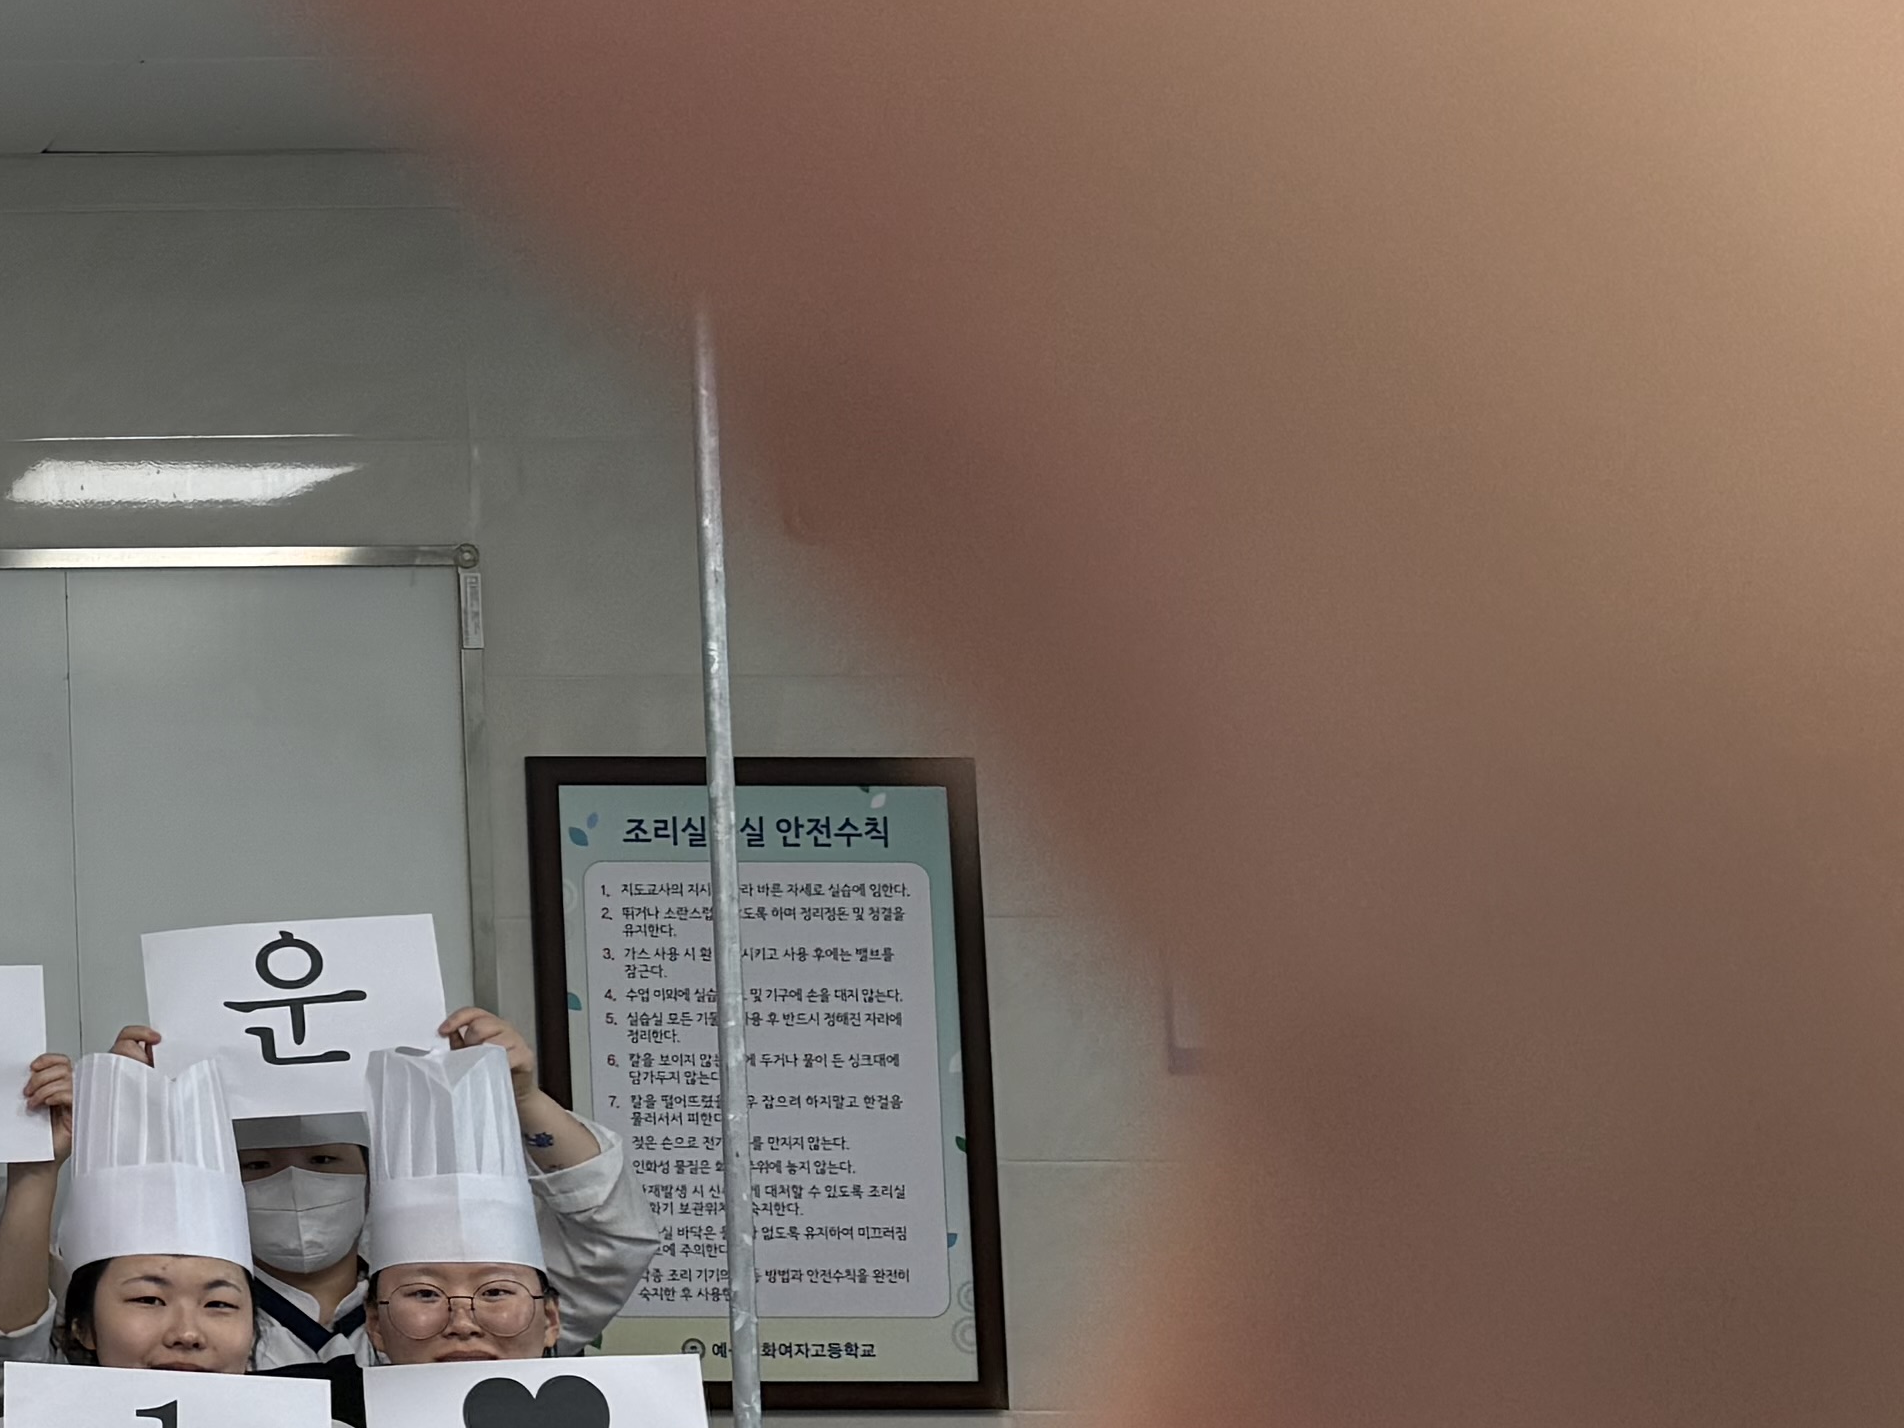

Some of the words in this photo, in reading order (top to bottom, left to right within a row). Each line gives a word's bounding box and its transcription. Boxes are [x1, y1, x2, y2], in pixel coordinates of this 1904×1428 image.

[622, 816, 765, 847] 조리실실
[776, 816, 888, 848] 안전수칙
[601, 885, 610, 897] 1.
[621, 882, 683, 897] 지도교사의
[688, 883, 711, 897] 지시
[757, 883, 782, 897] 바른
[787, 883, 825, 897] 자세로
[828, 883, 866, 898] 실습에
[869, 883, 910, 898] 임한다.
[601, 907, 613, 920] 2.
[622, 906, 659, 920] 뛰거나
[664, 906, 713, 921] 소란스럽
[741, 907, 768, 921] 도록
[771, 907, 796, 921] 하며
[800, 907, 849, 921] 정리정돈
[852, 907, 864, 921] 및
[869, 907, 905, 921] 청결을
[622, 924, 677, 938] 유지한다.
[603, 948, 615, 960] 3.
[624, 947, 651, 960] 가스
[654, 947, 680, 962] 사용
[684, 947, 695, 961] 시
[743, 947, 778, 961] 시키고
[783, 947, 809, 962] 사용
[812, 947, 852, 962] 후에는
[625, 964, 667, 979] 잠근다.
[224, 931, 366, 1065] 운
[604, 989, 616, 1001] 4.
[626, 988, 649, 1002] 수업
[750, 988, 762, 1003] 및
[765, 988, 802, 1002] 기구에
[806, 988, 831, 1003] 손을
[834, 988, 858, 1002] 대지
[862, 988, 903, 1003] 않는다.
[605, 1012, 617, 1025] 5.
[627, 1012, 662, 1027] 실습실
[666, 1012, 693, 1026] 모든
[766, 1012, 780, 1026] 후
[783, 1012, 819, 1027] 반드시
[824, 1012, 861, 1027] 정해진
[864, 1012, 902, 1027] 자리에
[627, 1029, 680, 1044] 정리한다.
[607, 1054, 619, 1067] 6.
[629, 1053, 654, 1067] 칼을
[658, 1053, 695, 1067] 보이지
[760, 1053, 799, 1067] 두거나
[803, 1053, 827, 1068] 물이
[831, 1054, 845, 1068] 든
[848, 1053, 899, 1068] 싱크대에
[608, 1096, 620, 1108] 7.
[631, 1095, 657, 1109] 칼을
[762, 1095, 801, 1109] 잡으려
[806, 1095, 859, 1109] 하지말고
[864, 1094, 903, 1110] 한걸음
[630, 1112, 683, 1126] 물러서서
[632, 1135, 657, 1150] 젖은
[661, 1136, 699, 1150] 손으로
[768, 1136, 804, 1151] 만지지
[807, 1136, 850, 1151] 않는다.
[632, 1160, 669, 1174] 인화성
[674, 1160, 711, 1175] 물질은
[786, 1160, 810, 1175] 놓지
[814, 1160, 856, 1175] 않는다.
[642, 1184, 687, 1199] 재발생
[692, 1184, 704, 1198] 시
[765, 1184, 804, 1199] 대처할
[808, 1185, 821, 1199] 수
[825, 1184, 864, 1199] 있도록
[867, 1185, 905, 1199] 조리실
[677, 1225, 717, 1241] 바닥은
[761, 1226, 800, 1241] 없도록
[803, 1226, 854, 1240] 유지하여
[858, 1226, 906, 1241] 미끄러짐
[667, 1268, 692, 1282] 조리
[765, 1269, 804, 1283] 방법과
[807, 1268, 869, 1283] 안전수칙을
[872, 1268, 909, 1283] 완전히
[680, 1287, 693, 1301] 후
[712, 1341, 876, 1359] 예화여자고등학교
